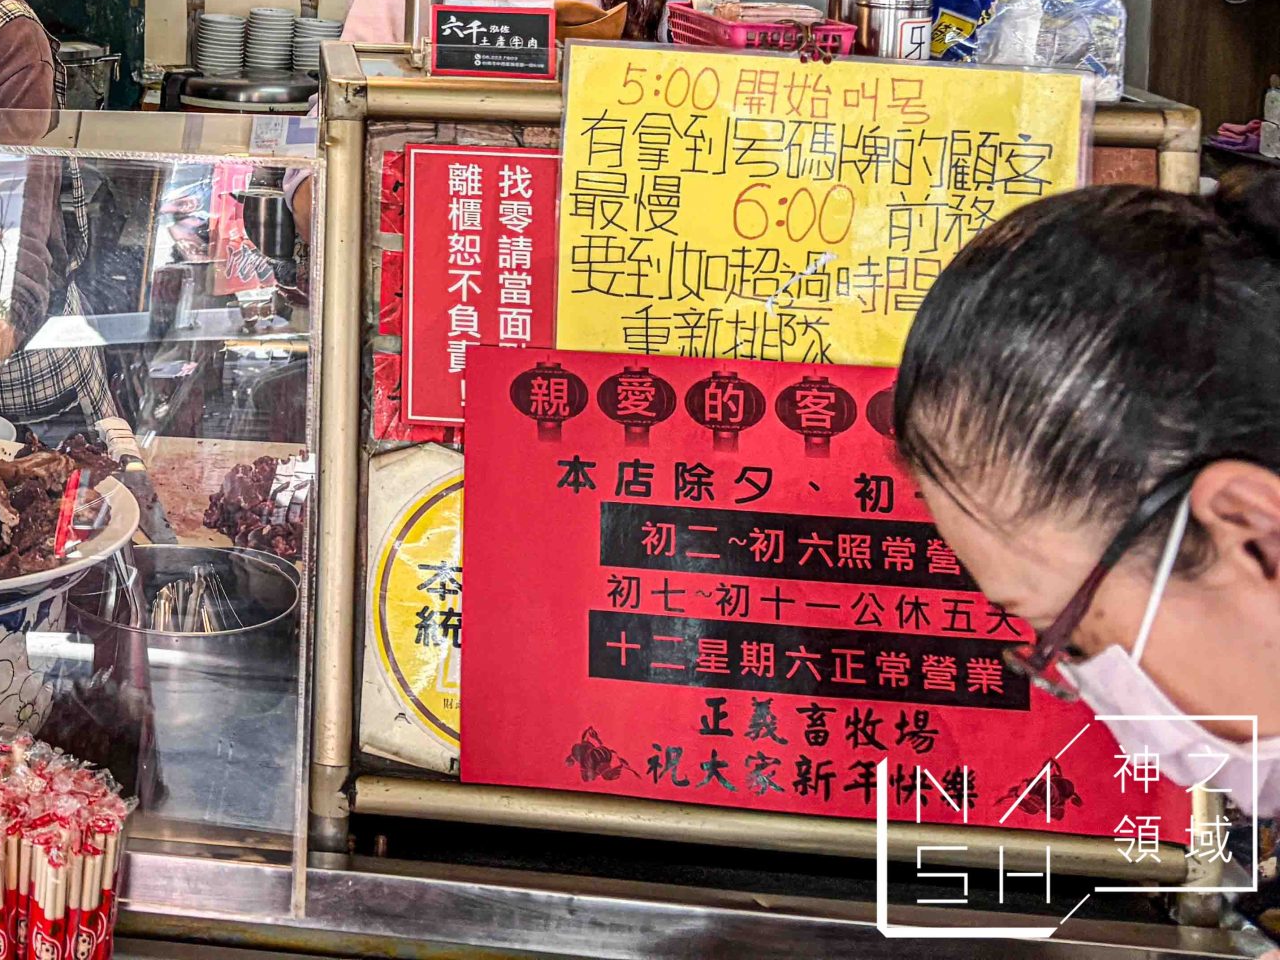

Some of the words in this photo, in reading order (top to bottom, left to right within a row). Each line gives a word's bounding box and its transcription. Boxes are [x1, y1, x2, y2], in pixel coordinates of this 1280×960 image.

[441, 15, 488, 44] 六千
[618, 62, 720, 110] 5:00
[733, 68, 931, 125] 開始叫号
[569, 170, 679, 236] 最慢
[733, 182, 856, 245] 6:00
[497, 164, 534, 349] 找零請當面
[556, 454, 924, 514] 本店除夕、初
[605, 630, 1005, 696] 十二星期六正常營業
[698, 695, 940, 755] 正義畜牧場
[644, 742, 980, 812] 祝大家新年快樂
